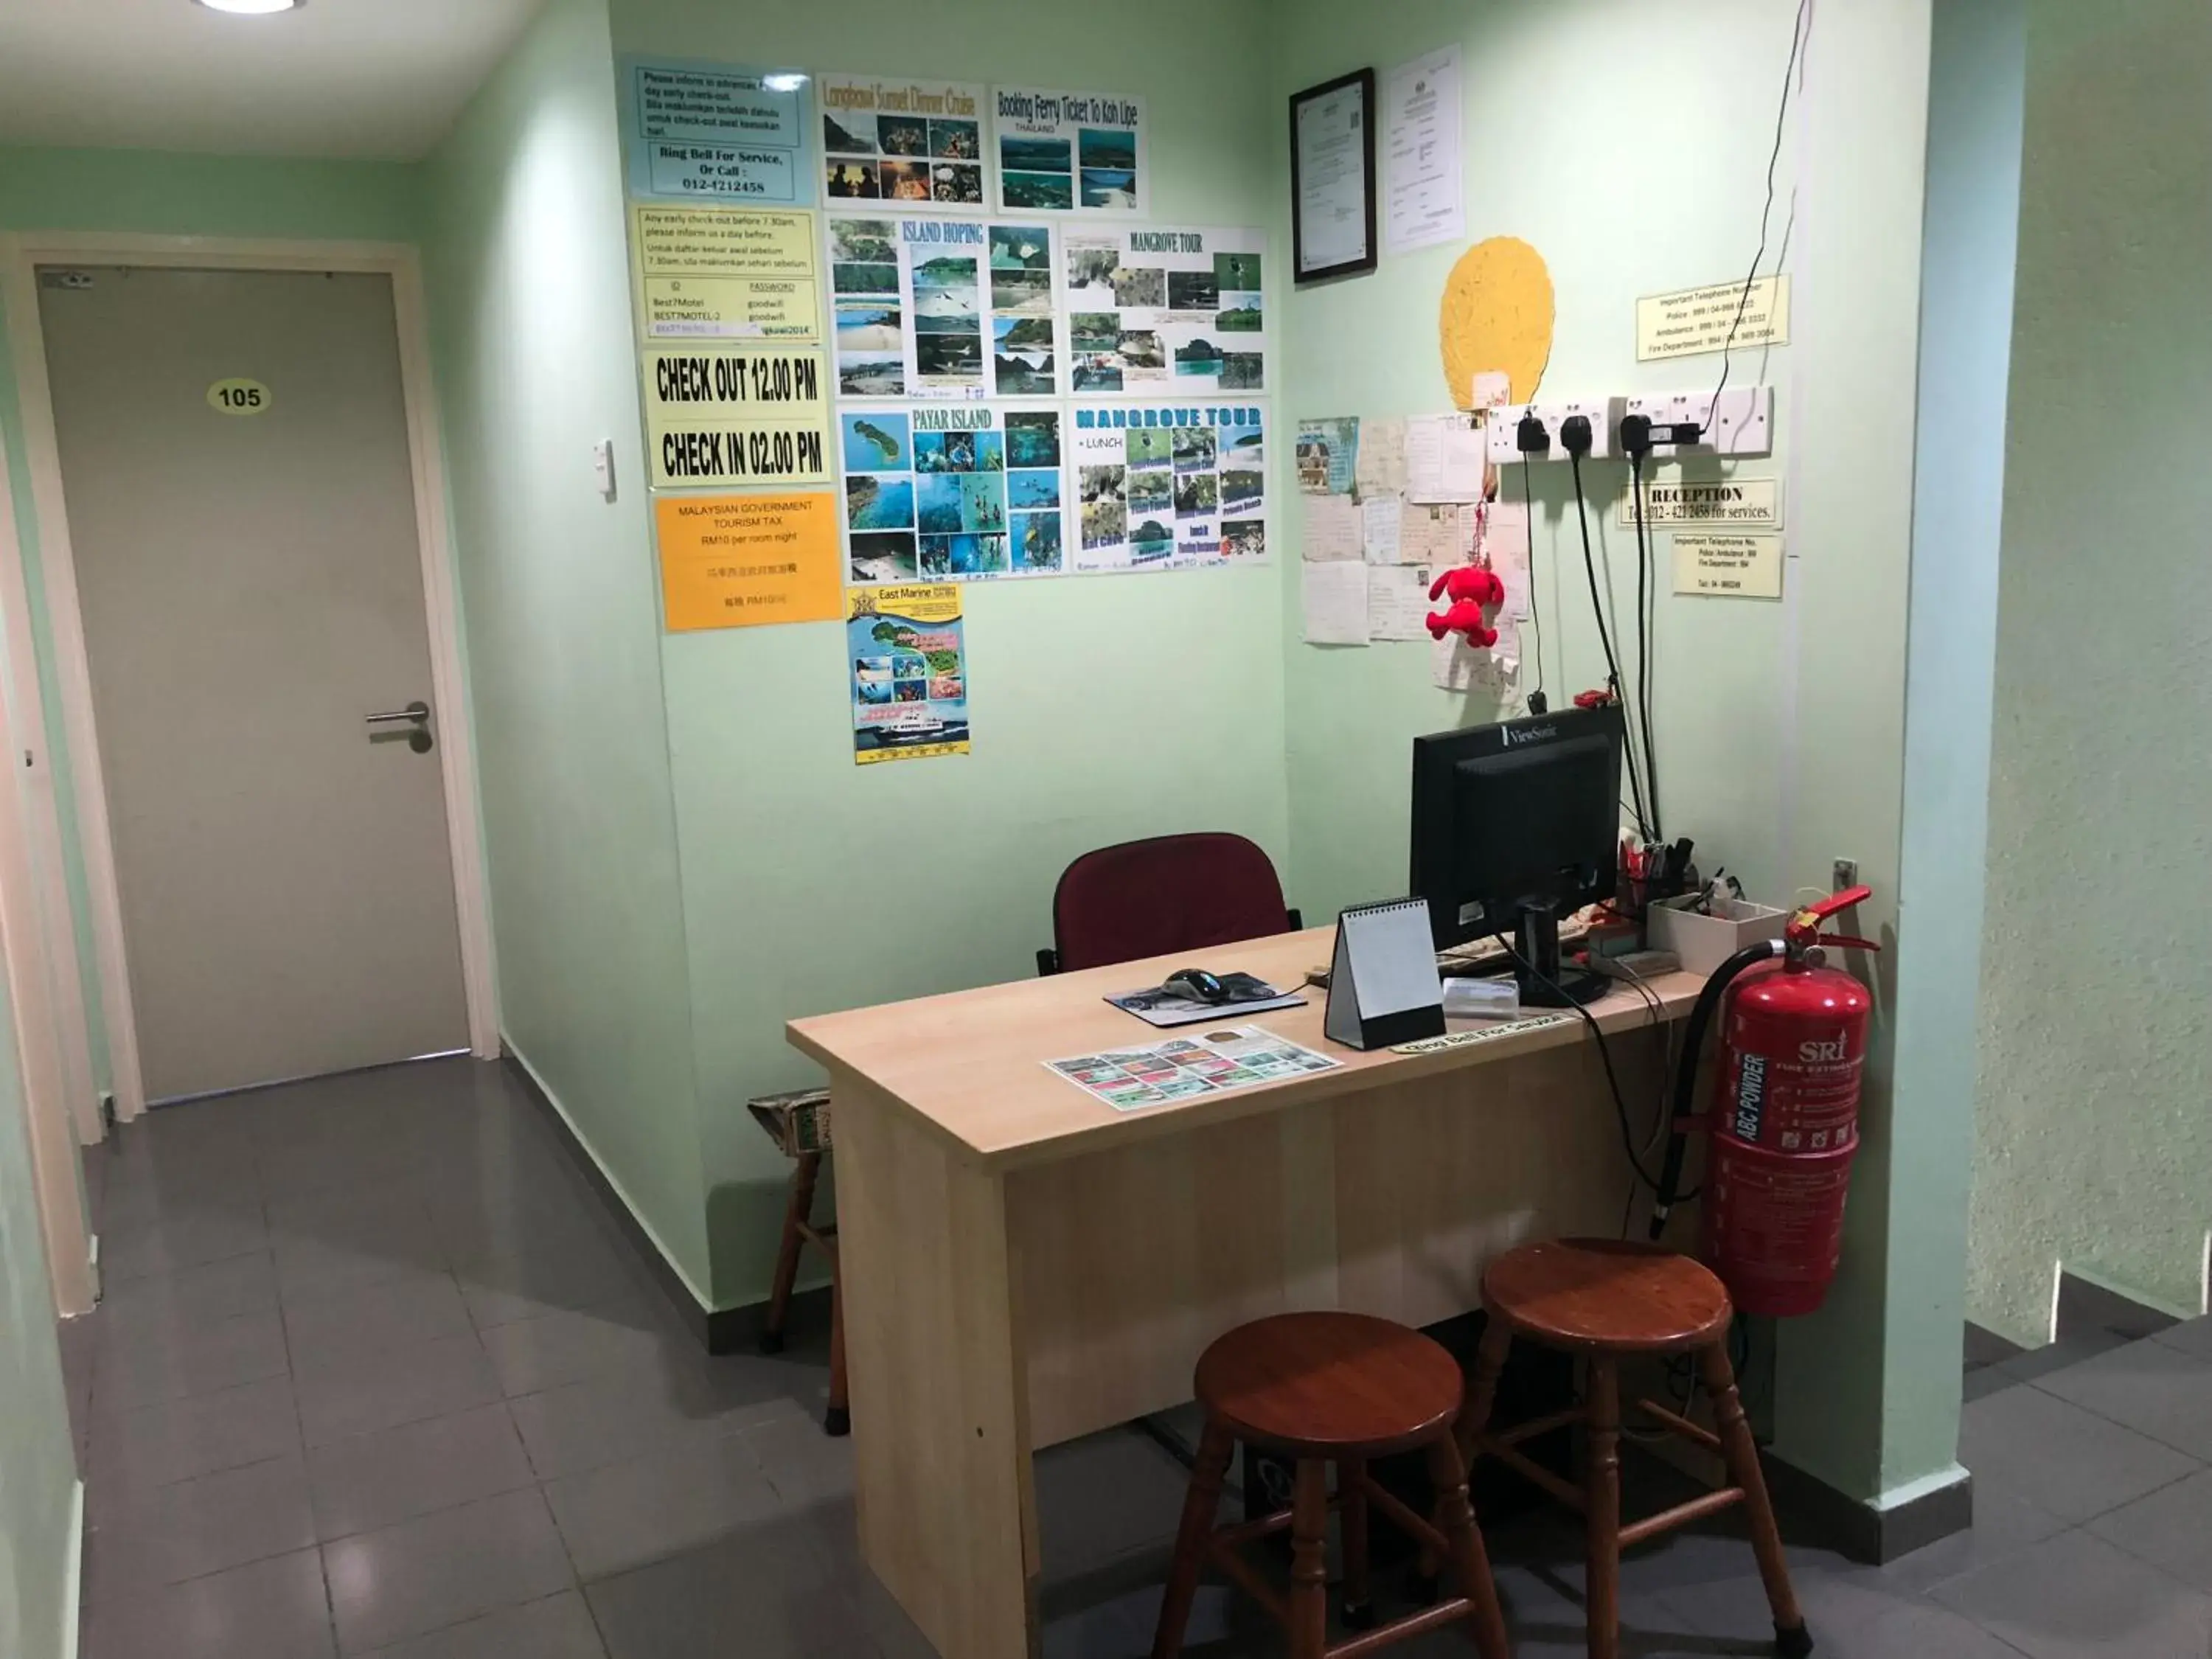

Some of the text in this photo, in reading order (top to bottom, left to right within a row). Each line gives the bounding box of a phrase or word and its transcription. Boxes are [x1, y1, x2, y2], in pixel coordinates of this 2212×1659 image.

[998, 91, 1032, 123] Booking
[1035, 94, 1060, 125] Ferry
[1062, 96, 1089, 123] Ticket
[1090, 98, 1101, 123] To
[1120, 100, 1138, 130] Lipe
[1015, 123, 1056, 133] THAILAND
[660, 147, 687, 160] Ring
[690, 147, 713, 161] Bell
[716, 150, 735, 161] For
[700, 164, 714, 175] Or
[717, 164, 739, 176] Call
[645, 214, 661, 223] Any
[664, 215, 685, 225] early
[733, 216, 760, 226] before
[646, 228, 674, 237] please
[677, 229, 706, 237] inform
[727, 230, 742, 240] day
[902, 221, 984, 244] ISLAND HOPING
[1130, 232, 1203, 253] MANGROVE TOUR
[749, 282, 796, 293] PASSWORD
[1695, 289, 1731, 301] Telephone
[1656, 325, 1693, 336] Ambulance
[1663, 338, 1703, 352] Department
[657, 358, 818, 402] CHECK OUT 12.00 PM
[218, 388, 260, 407] 105
[912, 408, 992, 429] PAYAR ISLAND
[1076, 407, 1261, 428] MANGROVE TOUR
[1086, 437, 1123, 449] LUNCH
[663, 431, 823, 476] CHECK IN 02.00 PM
[1652, 487, 1743, 503] RECEPTION
[678, 501, 813, 516] MALAYSIAN GOVERNMENT
[1711, 504, 1725, 519] for
[1728, 504, 1770, 519] services.
[714, 516, 783, 529] TOURISM TAX
[702, 532, 797, 546] RM10 per room night
[879, 588, 899, 599] East
[900, 588, 931, 598] Marine
[1446, 1032, 1478, 1045] Bell
[1478, 1026, 1506, 1038] For
[1736, 1053, 1765, 1141] ABC POWDER
